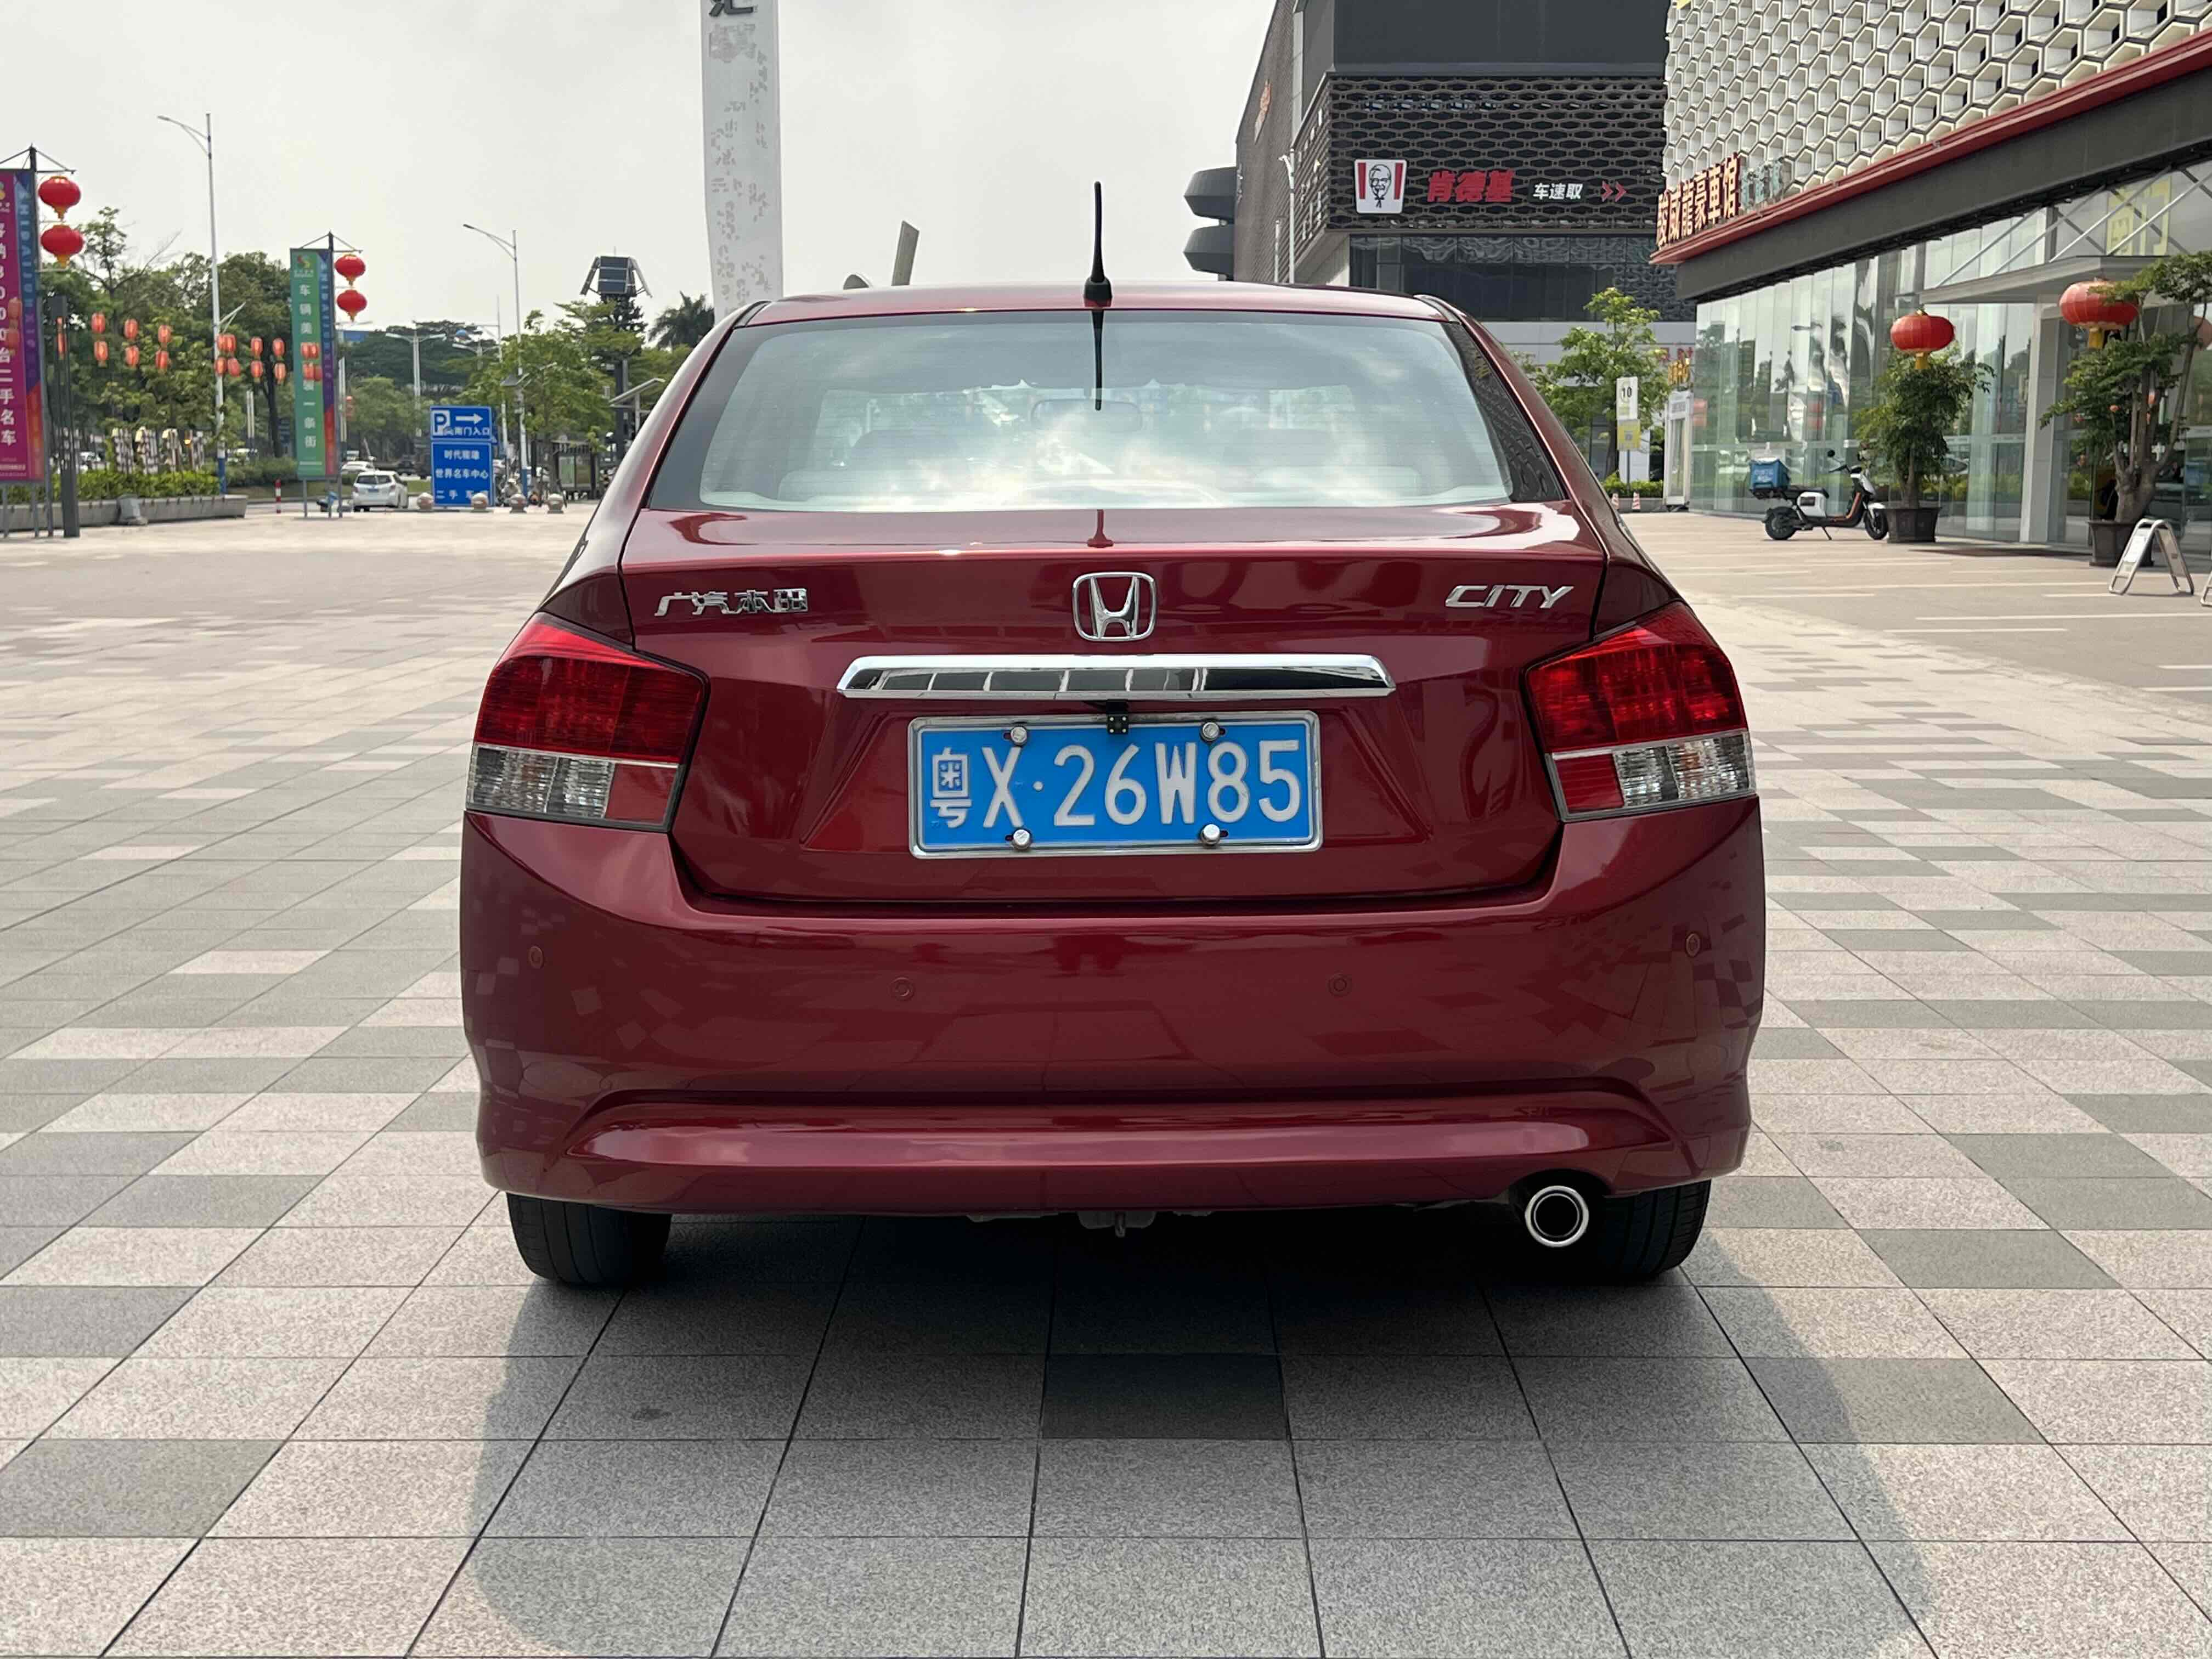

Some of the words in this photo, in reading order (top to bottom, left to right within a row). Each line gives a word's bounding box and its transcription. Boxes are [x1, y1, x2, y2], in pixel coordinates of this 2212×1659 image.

[1427, 169, 1516, 203] 肯德基
[1532, 182, 1584, 201] 车速取
[434, 413, 448, 433] P
[654, 588, 808, 617] 广汽本田
[1444, 584, 1575, 609] CITY
